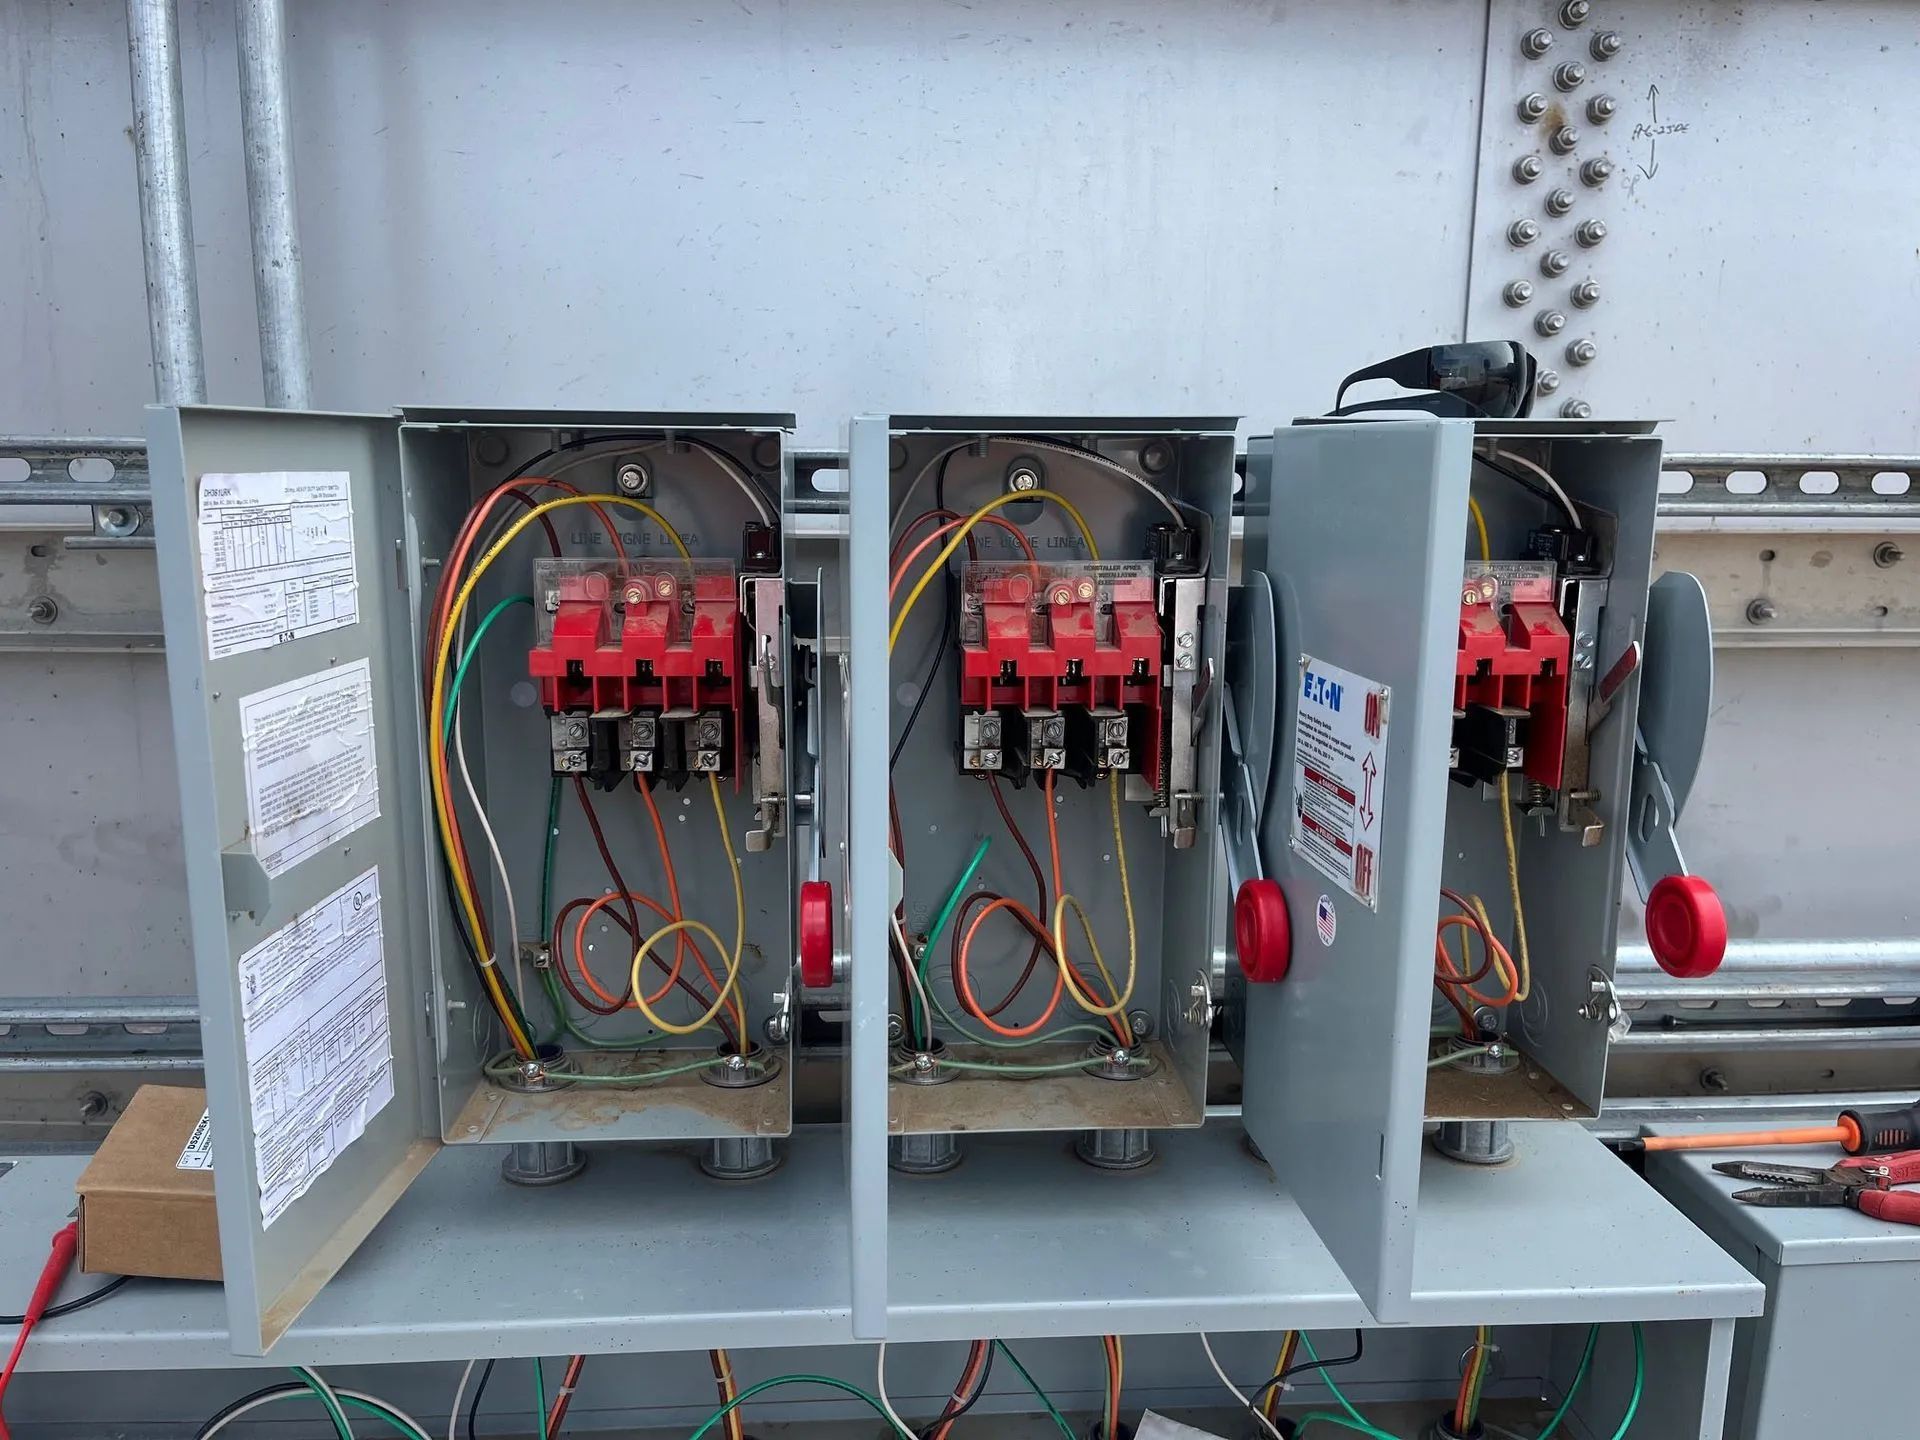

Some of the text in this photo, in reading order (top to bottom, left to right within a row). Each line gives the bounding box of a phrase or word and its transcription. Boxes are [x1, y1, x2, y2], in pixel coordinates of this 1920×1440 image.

[571, 533, 602, 545] LINE
[1047, 536, 1086, 548] LINEA
[1304, 672, 1342, 713] EATON
[1364, 691, 1381, 741] ON
[1322, 779, 1339, 795] DANGER
[1354, 843, 1373, 896] OFF
